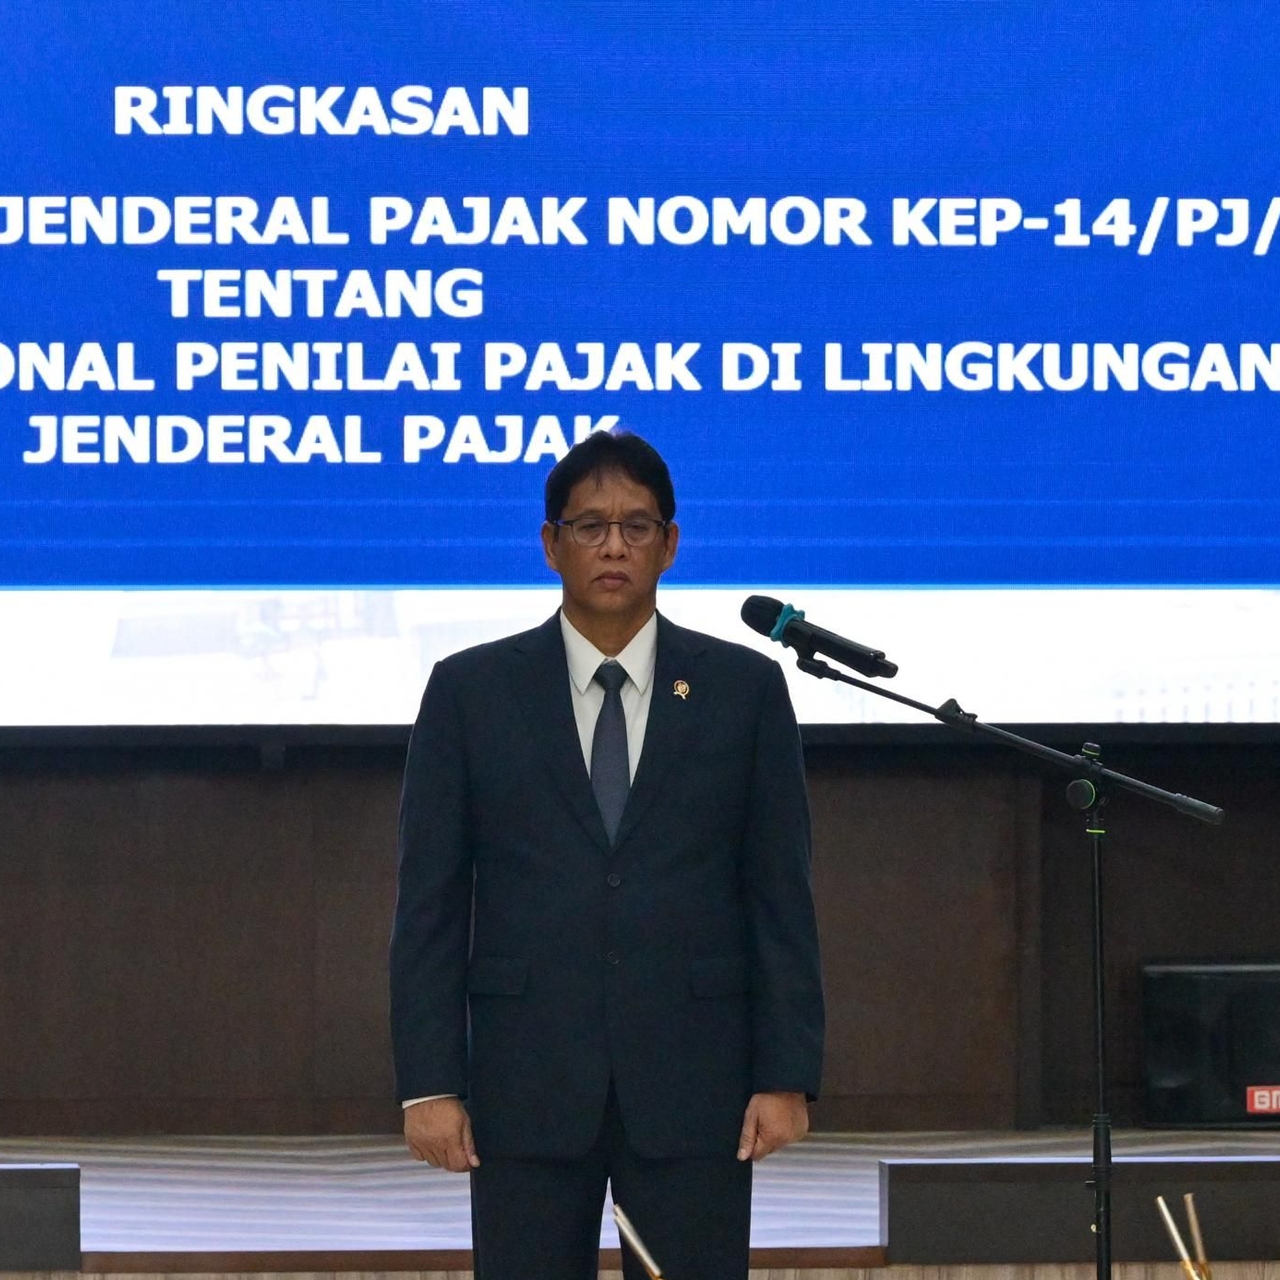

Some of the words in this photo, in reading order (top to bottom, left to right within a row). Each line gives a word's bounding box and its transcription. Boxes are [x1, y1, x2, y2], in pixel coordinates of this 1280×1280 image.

[114, 84, 529, 136] RINGKASAN
[370, 196, 588, 246] PAJAK
[608, 195, 872, 246] NOMOR
[157, 268, 483, 318] TENTANG
[176, 342, 461, 392] PENILAI
[484, 342, 702, 392] PAJAK
[722, 342, 802, 392] DI
[23, 415, 382, 464] JENDERAL
